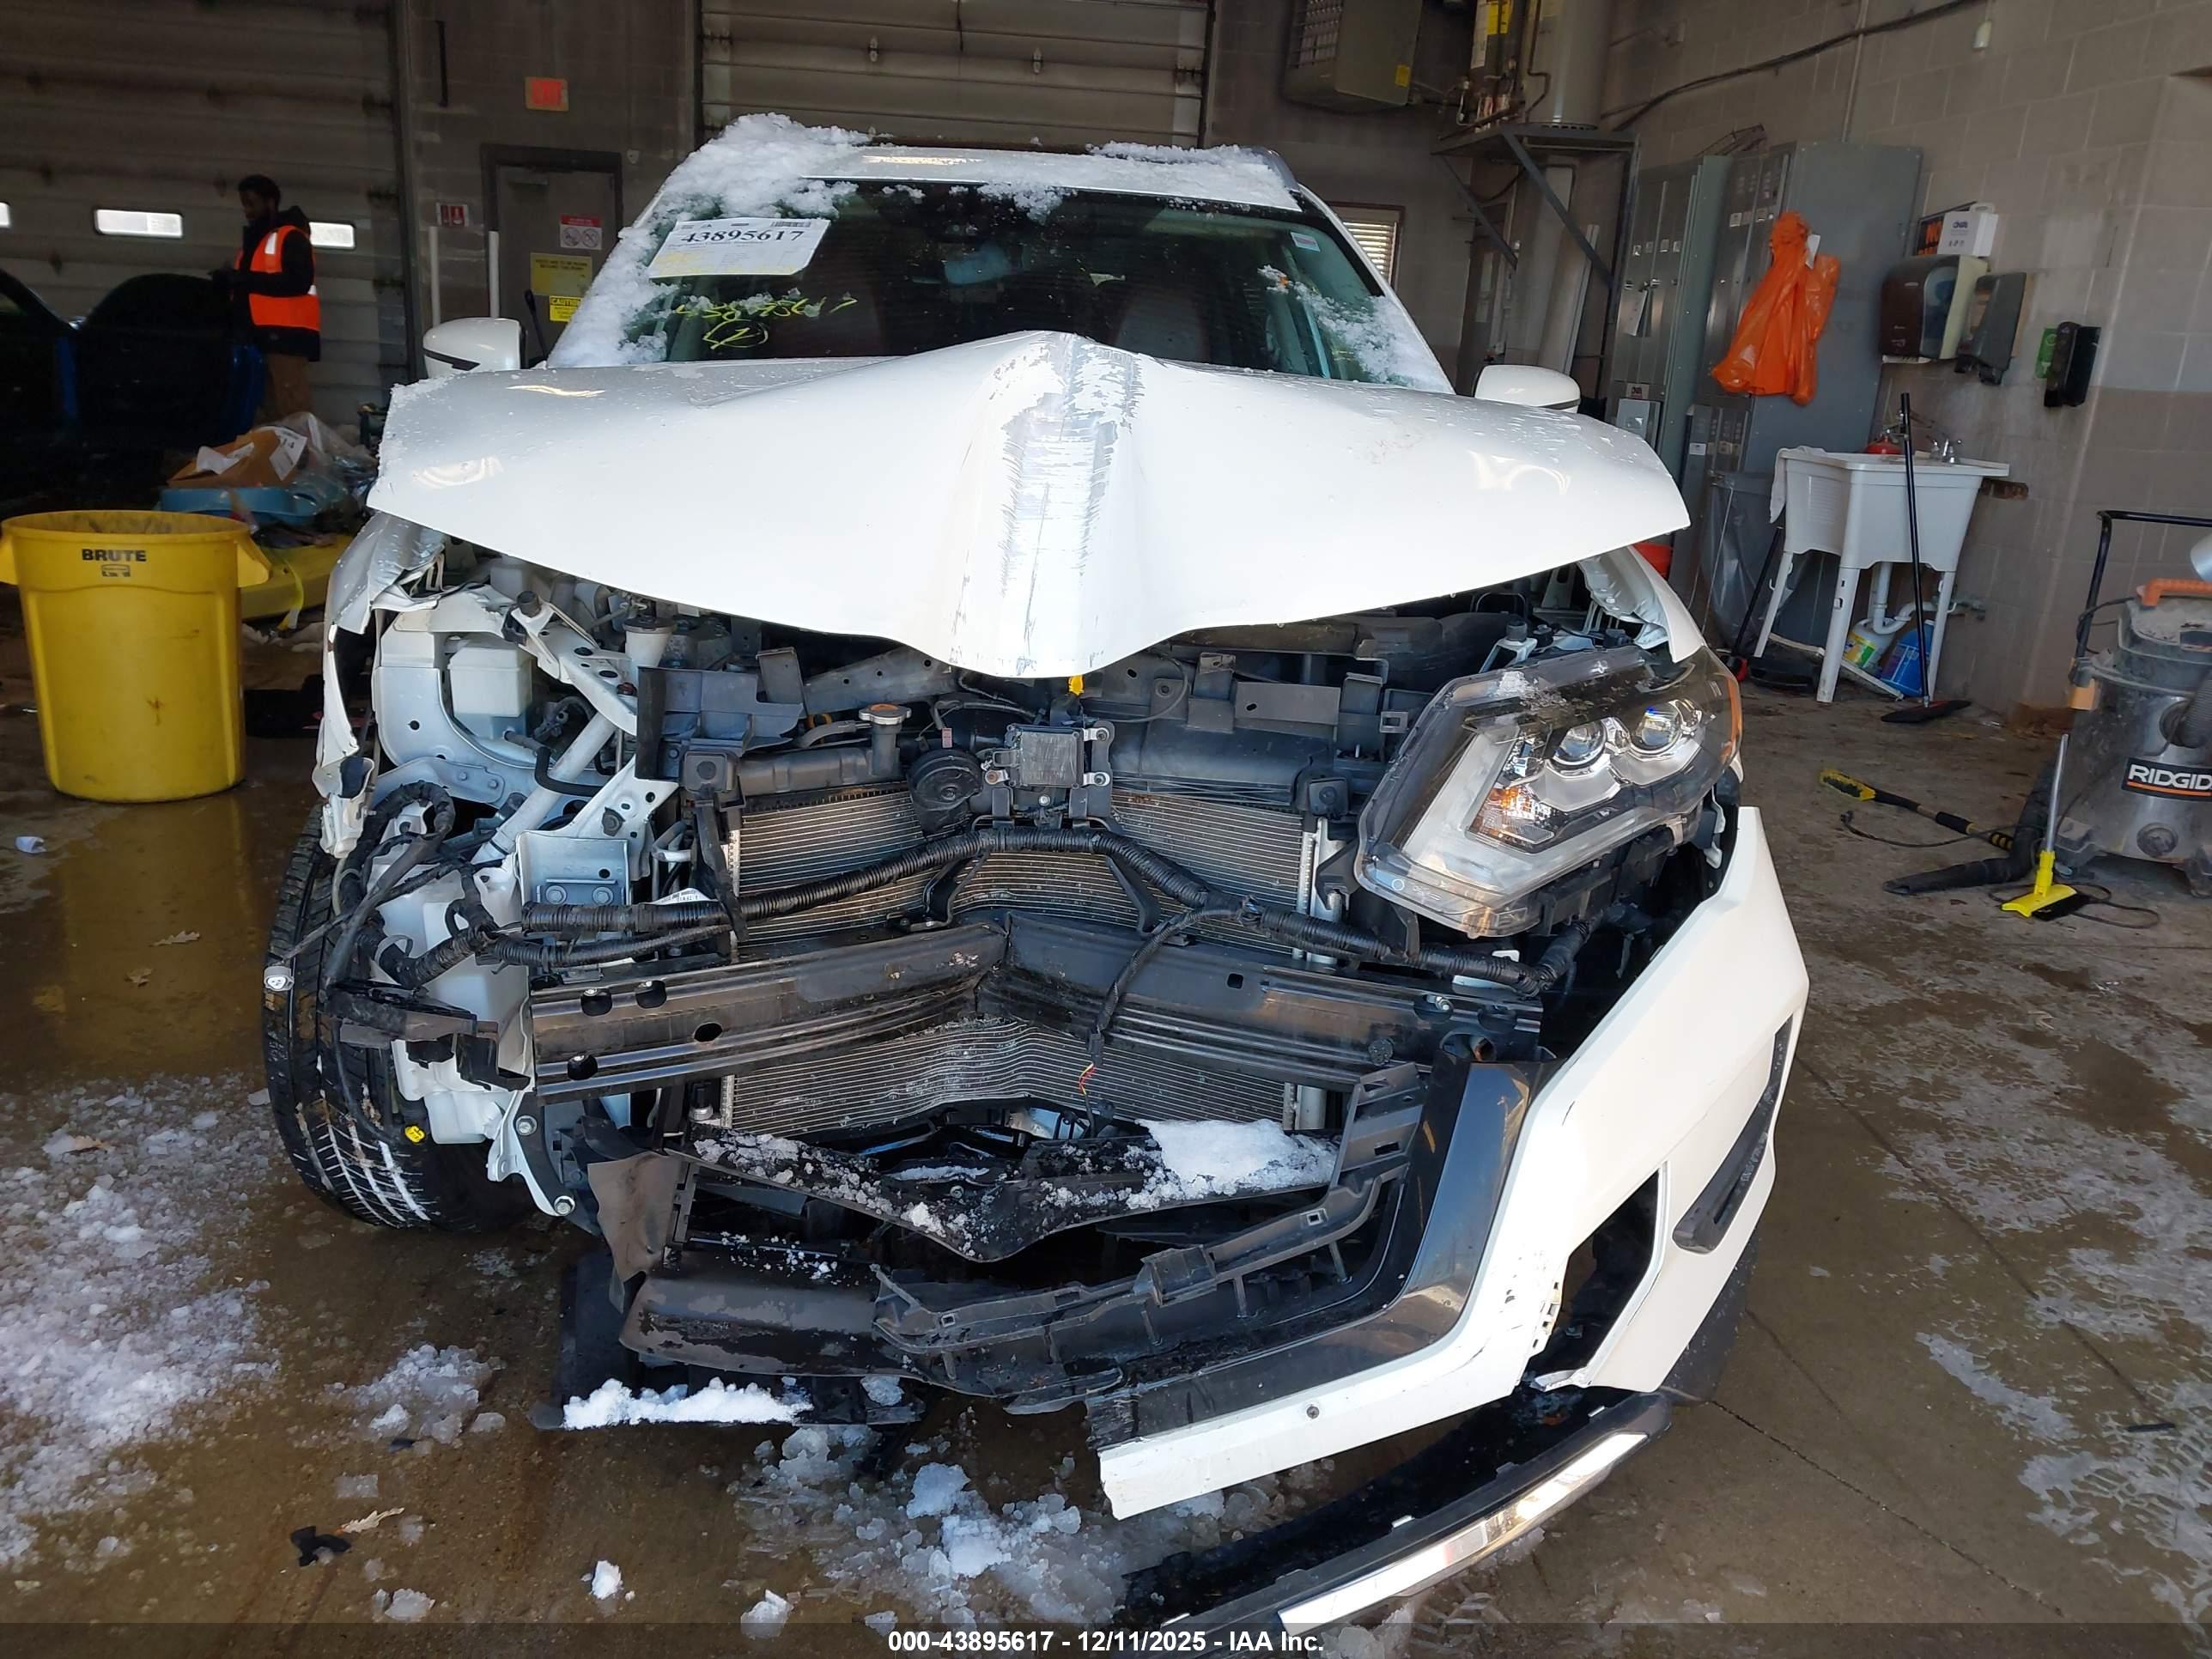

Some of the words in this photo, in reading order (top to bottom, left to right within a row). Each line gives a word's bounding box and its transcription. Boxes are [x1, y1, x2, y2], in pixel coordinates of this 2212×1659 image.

[681, 228, 805, 243] 43895617
[82, 548, 147, 562] BRUTE
[2128, 763, 2212, 791] RIDGID
